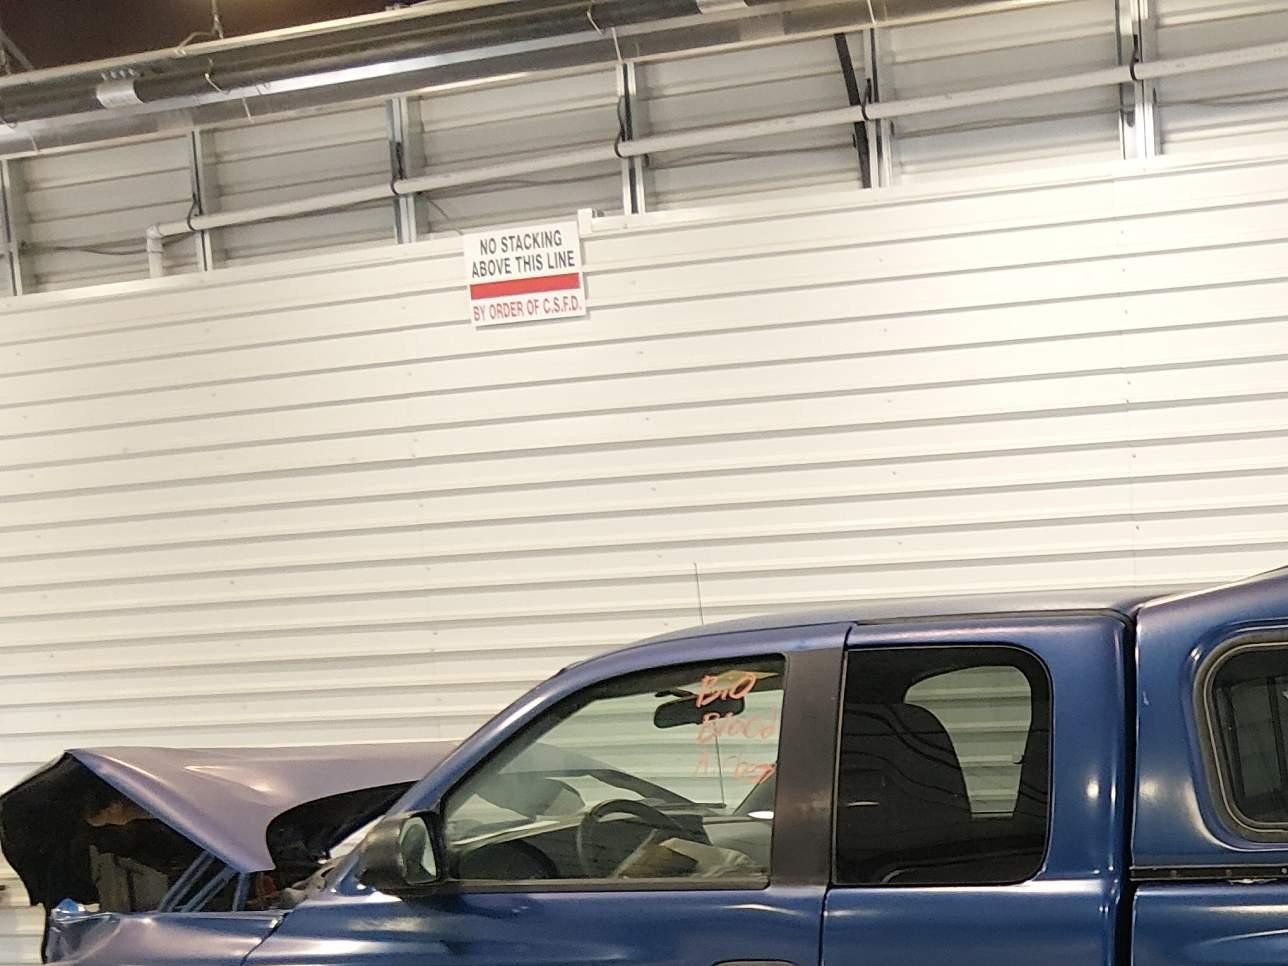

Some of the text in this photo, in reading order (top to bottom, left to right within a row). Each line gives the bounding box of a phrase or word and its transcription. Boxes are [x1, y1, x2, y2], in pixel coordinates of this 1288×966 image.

[480, 229, 562, 256] NO STACKING
[471, 250, 576, 279] ABOVE THIS LINE
[473, 295, 583, 322] BY ORDER OF C.S.F.D.
